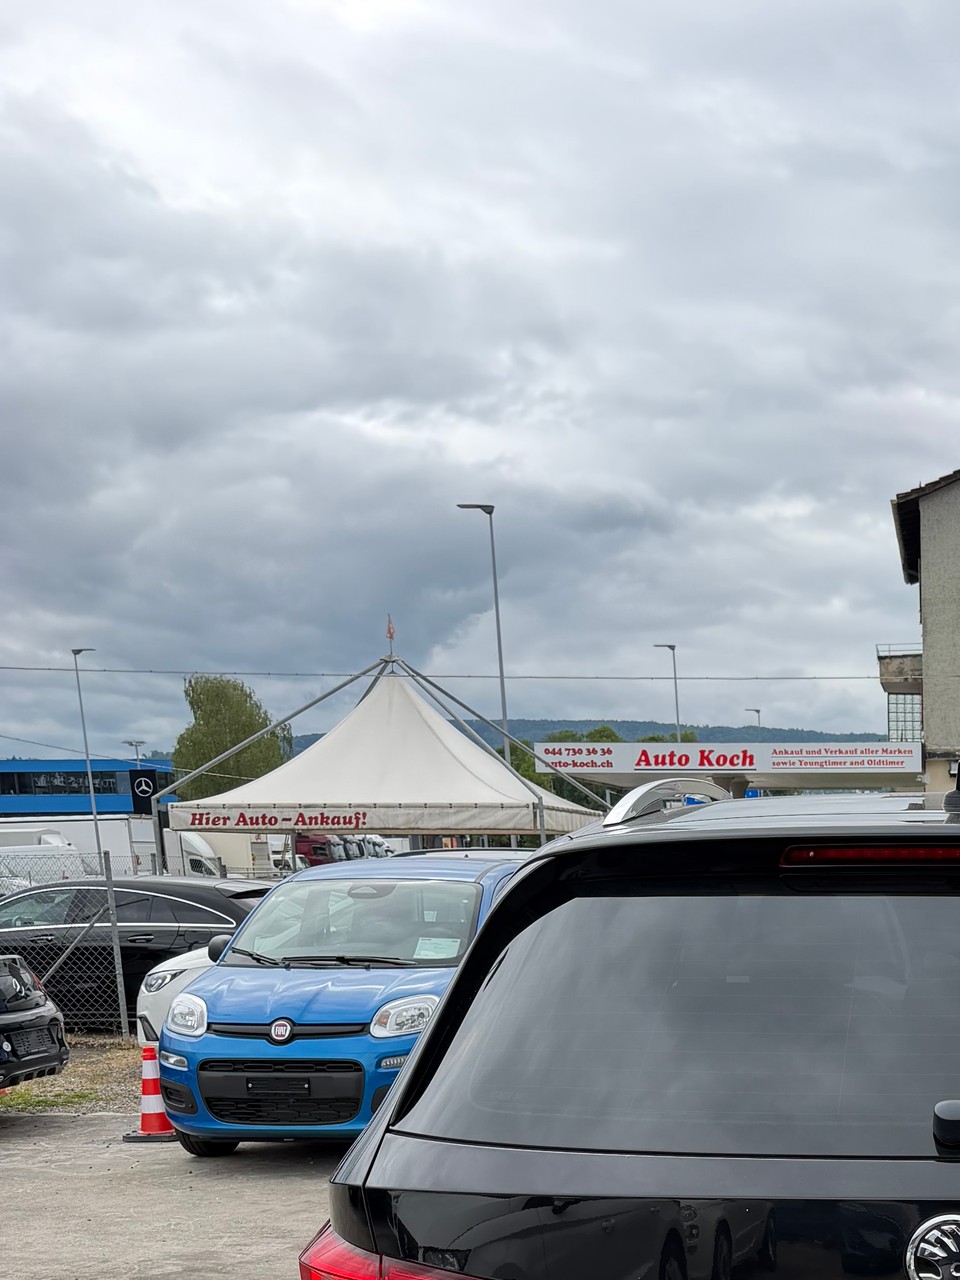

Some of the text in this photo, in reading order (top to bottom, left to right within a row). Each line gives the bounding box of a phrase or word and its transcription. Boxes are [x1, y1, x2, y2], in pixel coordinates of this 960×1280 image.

[544, 747, 613, 756] 044 730 36 36
[771, 748, 803, 756] Ankauf
[634, 749, 755, 767] Auto Koch
[771, 759, 796, 767] sowie
[798, 759, 847, 768] Youngtimer
[867, 759, 905, 767] Oldtimer
[190, 812, 230, 826] Hier
[276, 1026, 287, 1035] FIAT
